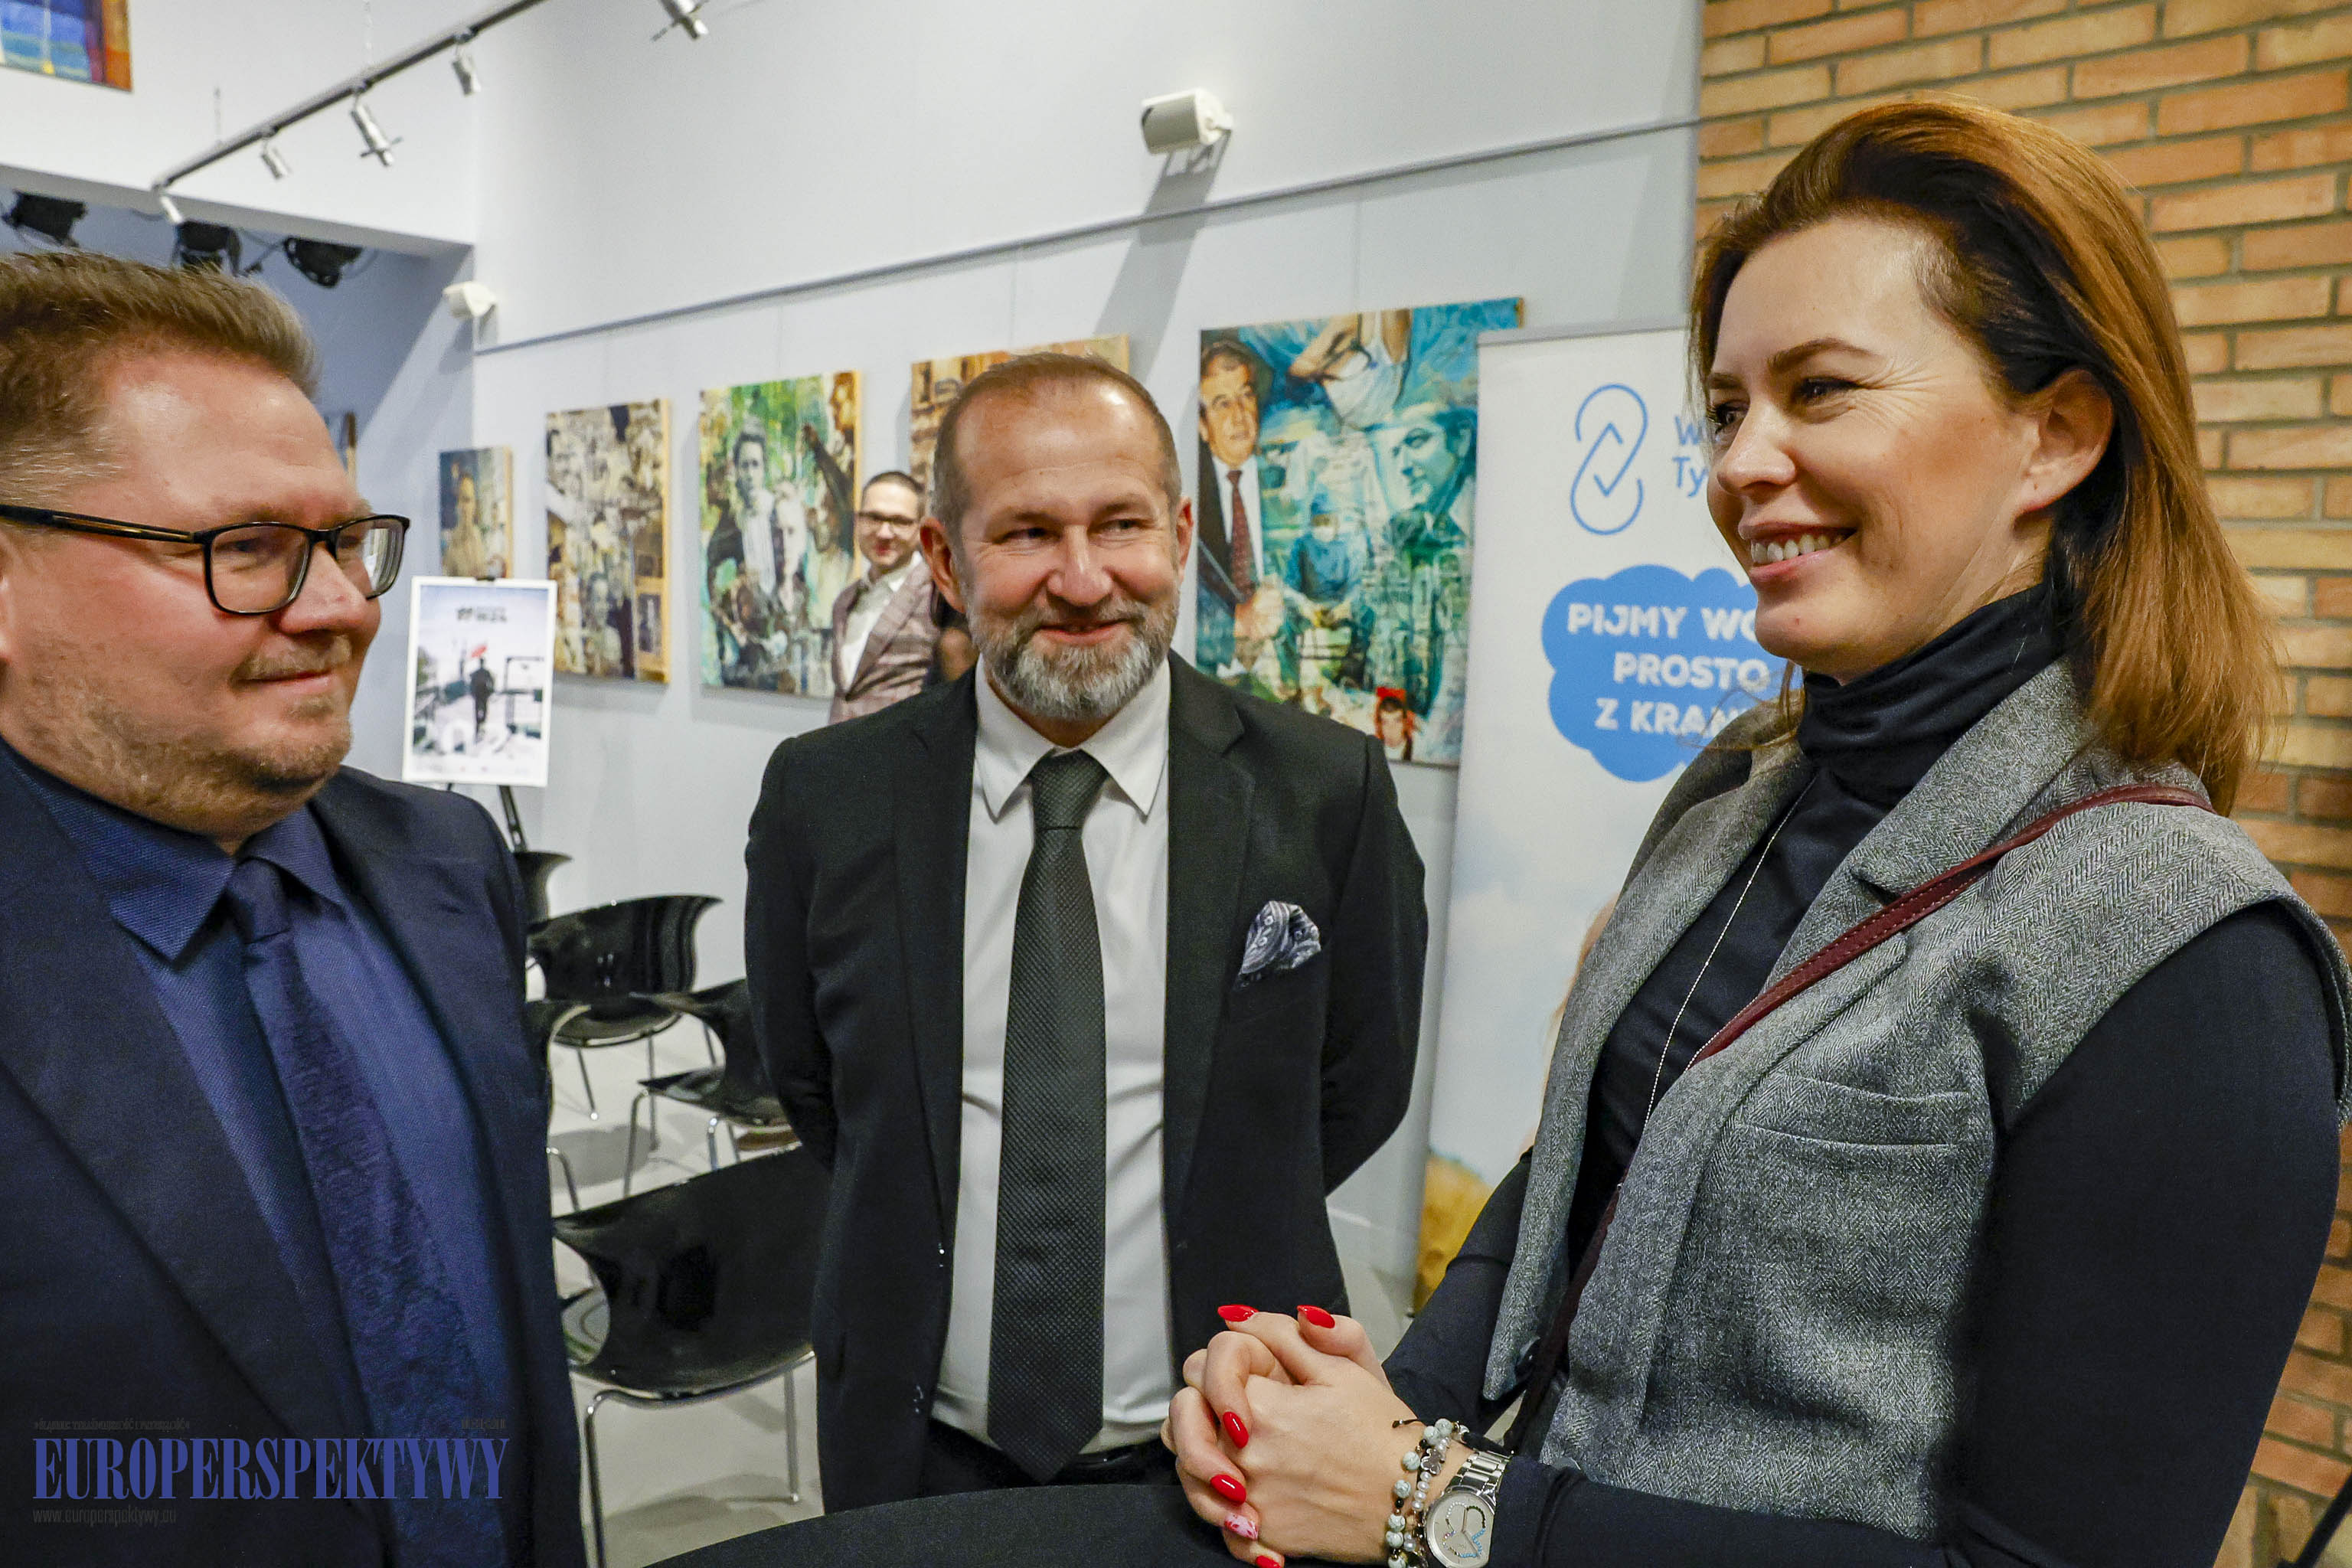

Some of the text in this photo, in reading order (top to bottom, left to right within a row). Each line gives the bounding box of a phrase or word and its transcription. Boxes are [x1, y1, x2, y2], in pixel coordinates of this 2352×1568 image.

[1672, 456, 1708, 498] Ty
[1567, 603, 1759, 643] PIJMY WO
[1613, 652, 1771, 693] PROSTO
[1595, 697, 1619, 730] Z
